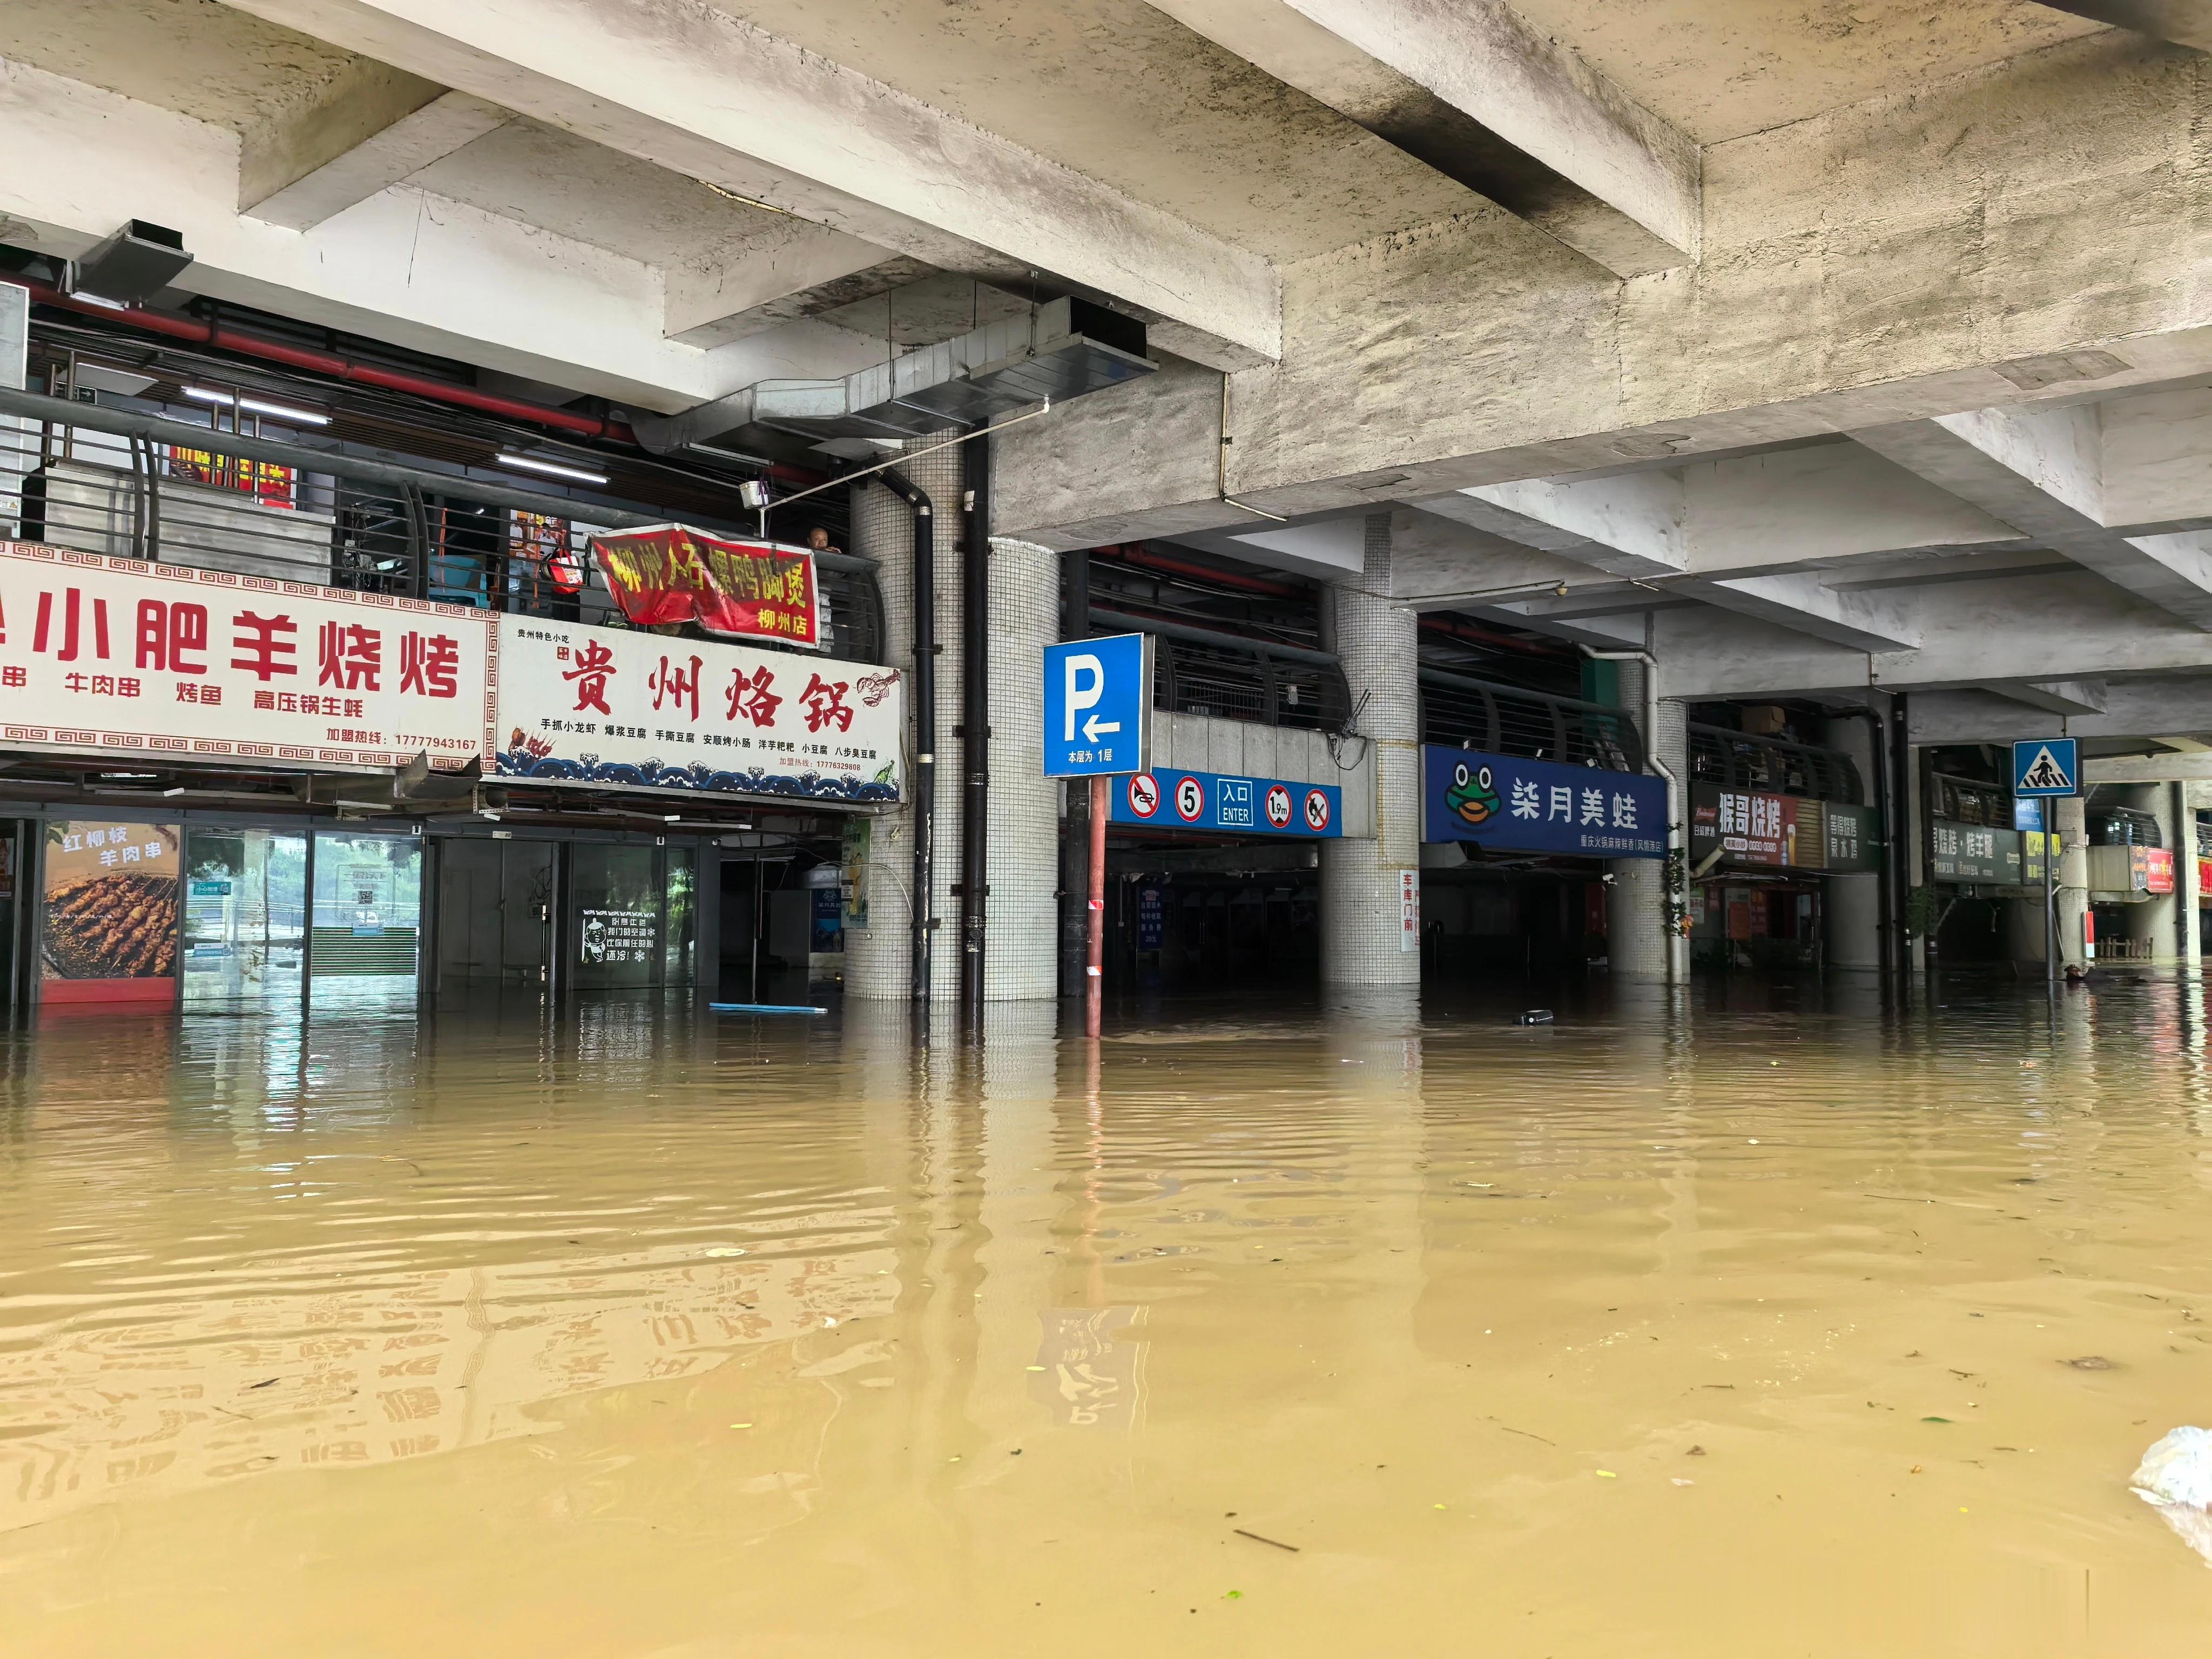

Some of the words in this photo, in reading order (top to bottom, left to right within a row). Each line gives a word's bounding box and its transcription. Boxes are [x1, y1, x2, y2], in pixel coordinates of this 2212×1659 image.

[758, 609, 807, 635] 柳州店
[0, 588, 458, 698] 小肥羊烧烤
[517, 629, 569, 643] 贵州特色小吃
[65, 672, 140, 697] 牛肉串
[176, 682, 221, 705] 烤鱼
[254, 690, 363, 718] 高压锅生蚝
[562, 639, 854, 733] 贵州烙锅
[1065, 654, 1104, 741] P
[395, 734, 476, 750] 17777943167
[541, 718, 596, 734] 手抓小龙虾
[605, 725, 647, 739] 爆浆豆腐
[655, 730, 695, 743] 手撕豆腐
[703, 734, 751, 748] 安顺烤小肠
[759, 739, 795, 752] 洋芋粑粑
[802, 743, 828, 756] 小豆腐
[835, 747, 876, 760] 八步臭豆腐
[817, 760, 861, 771] 17776329808
[1068, 750, 1092, 764] 本层为
[1098, 748, 1112, 763] 1层
[1184, 786, 1195, 813] 5
[1224, 784, 1247, 801] 入口
[1511, 778, 1638, 830] 柒月美蛙
[1223, 807, 1249, 821] ENTER
[1270, 797, 1287, 815] 1.9m
[1719, 793, 1781, 838] 猴哥烧烤
[63, 826, 127, 853] 红柳枝
[99, 842, 161, 866] 羊肉串
[1403, 874, 1412, 930] 车库门前
[606, 939, 653, 948] 比你前任的心
